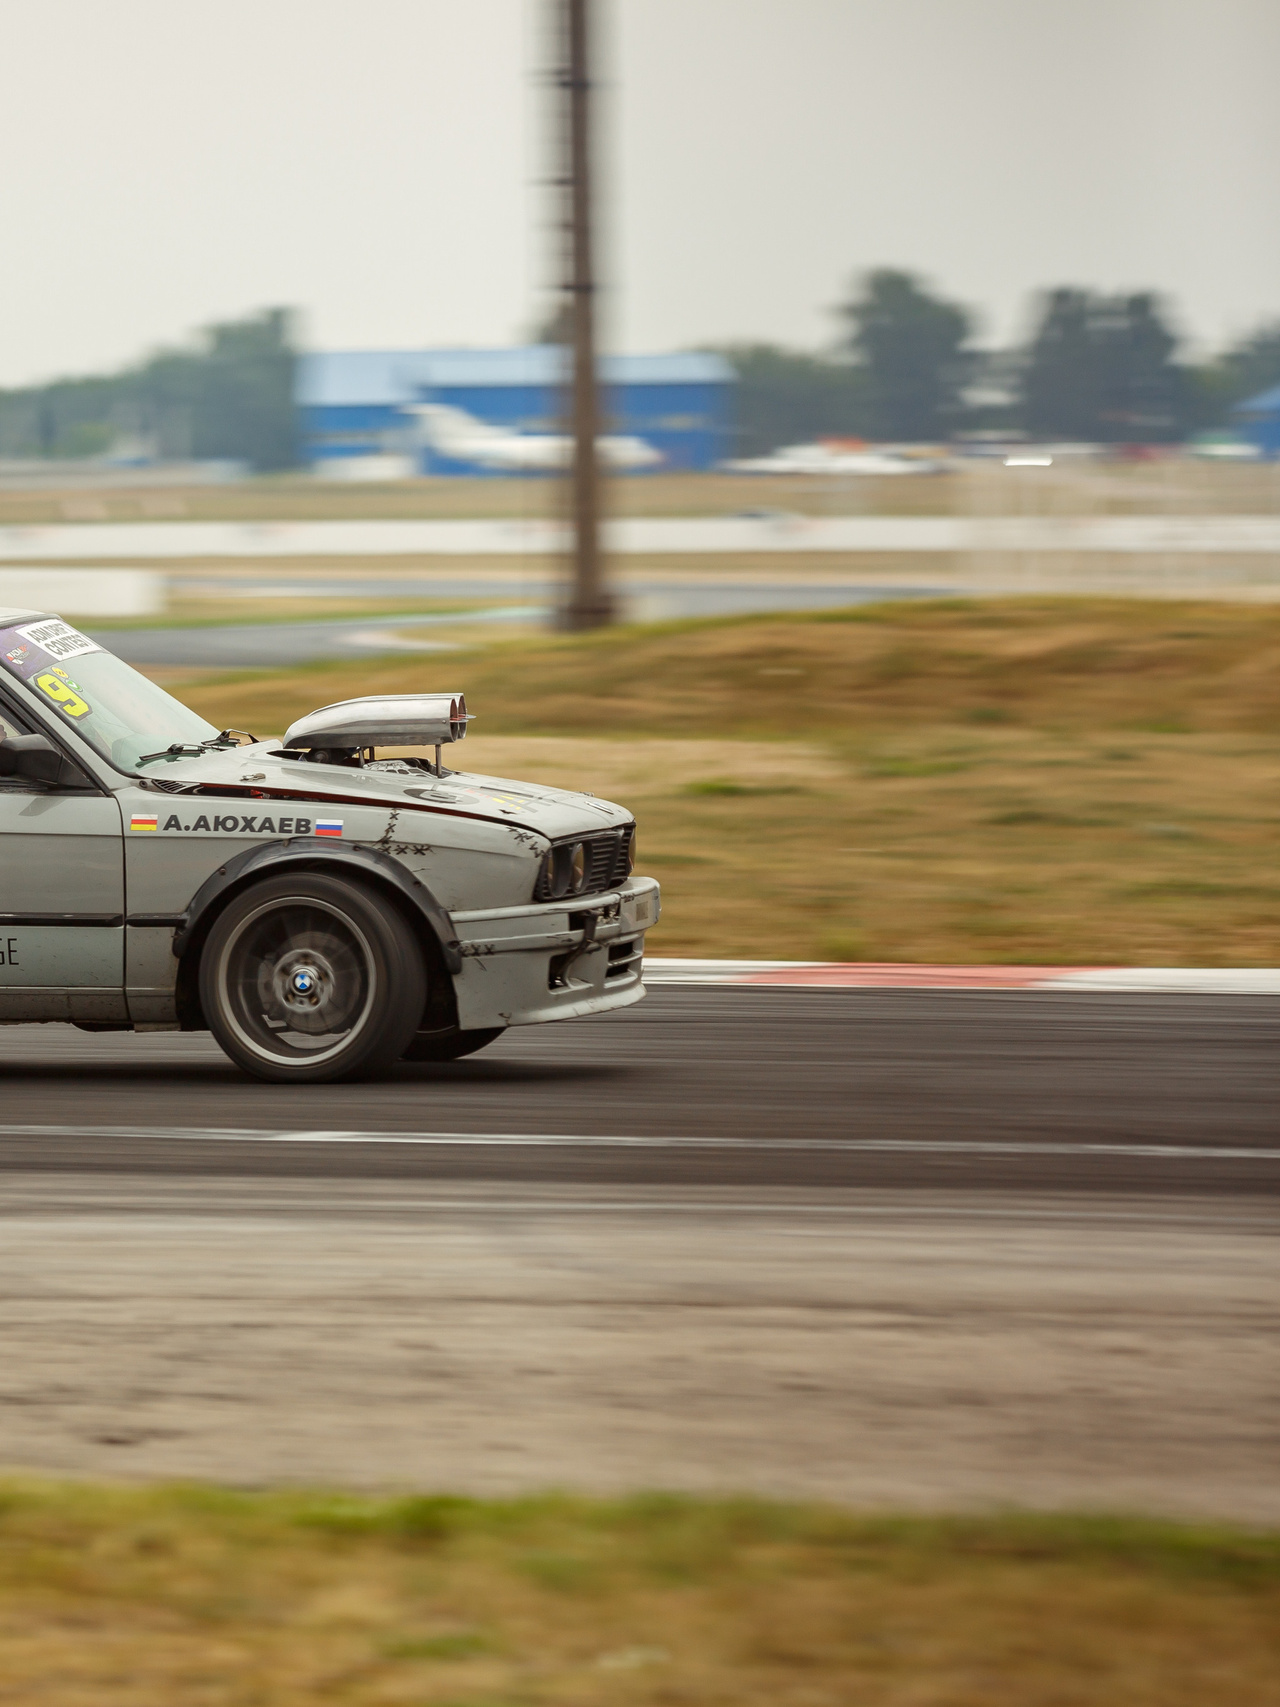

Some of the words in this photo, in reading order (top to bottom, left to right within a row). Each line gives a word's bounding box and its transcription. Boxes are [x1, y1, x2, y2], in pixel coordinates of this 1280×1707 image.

[44, 634, 90, 655] CONTEST
[35, 673, 91, 718] 9
[162, 814, 312, 834] А.АЮХАЕВ
